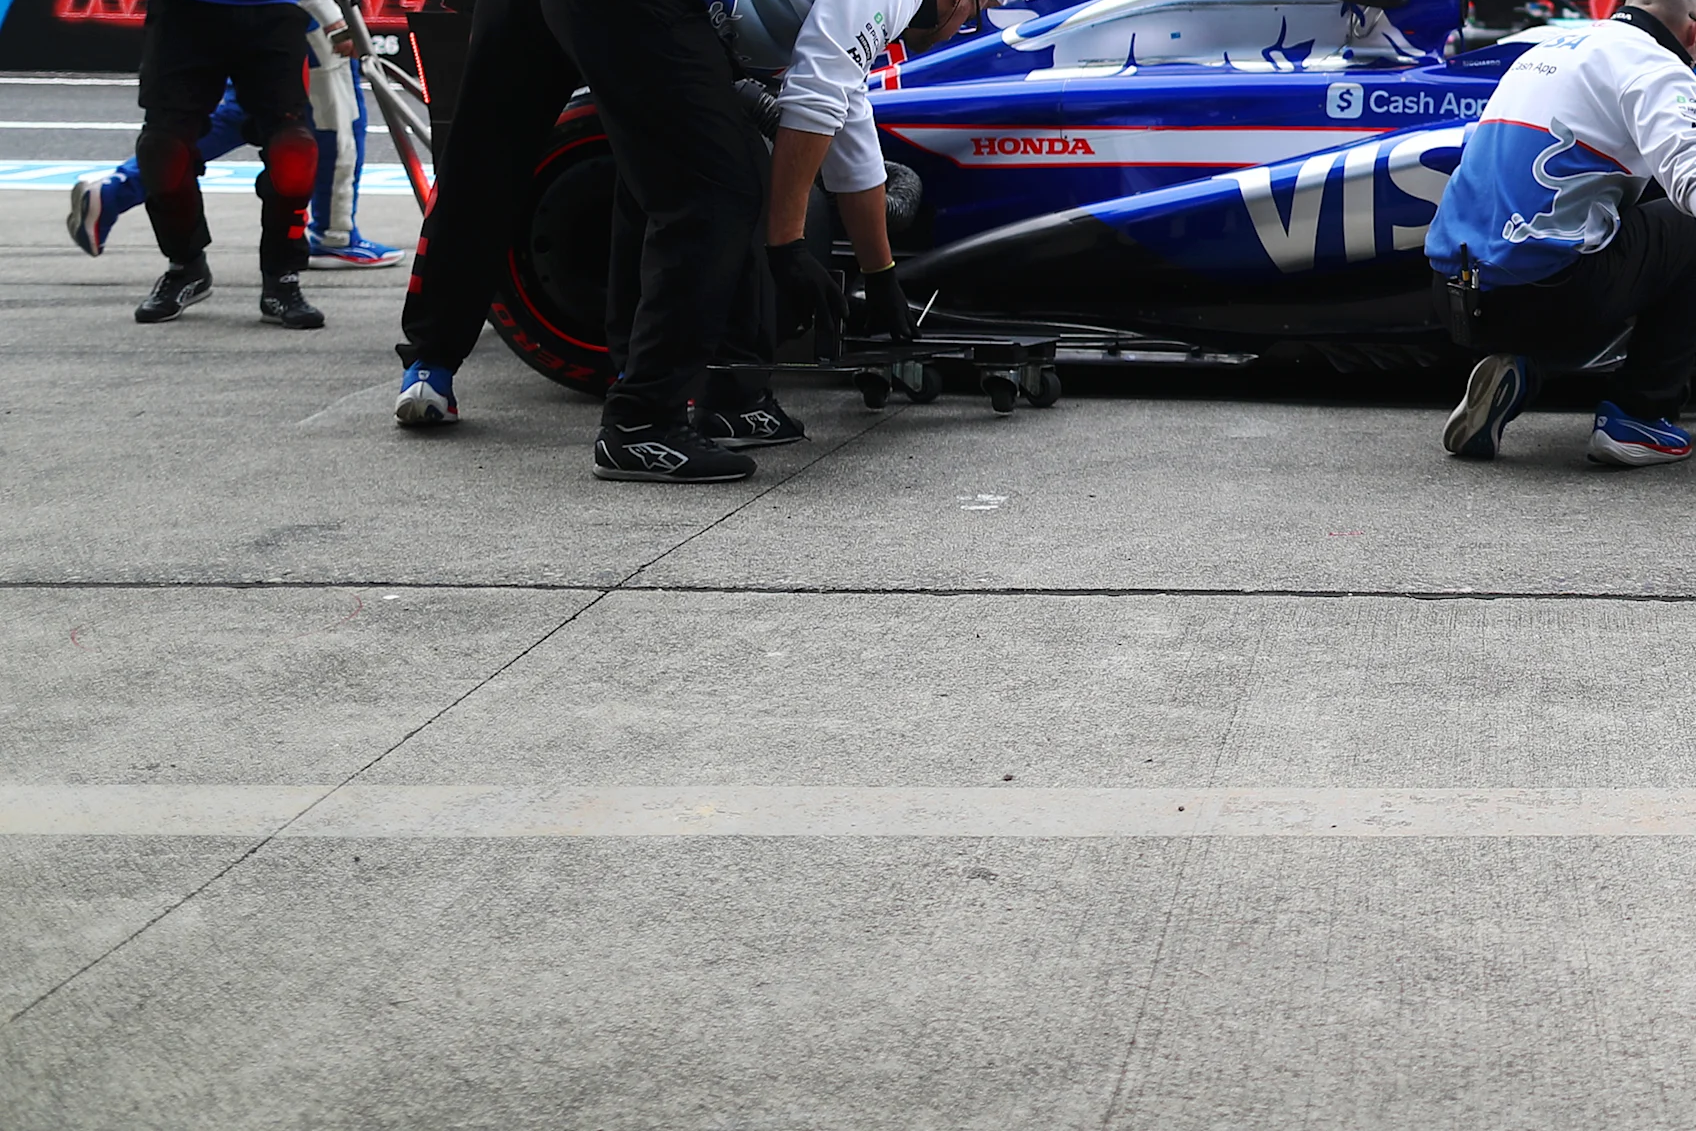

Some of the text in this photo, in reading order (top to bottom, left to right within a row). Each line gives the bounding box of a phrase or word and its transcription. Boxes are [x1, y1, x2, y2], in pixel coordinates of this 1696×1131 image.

[1533, 62, 1557, 76] App
[1369, 90, 1434, 114] Cash
[969, 137, 1096, 156] HONDA
[1211, 127, 1466, 274] VIS
